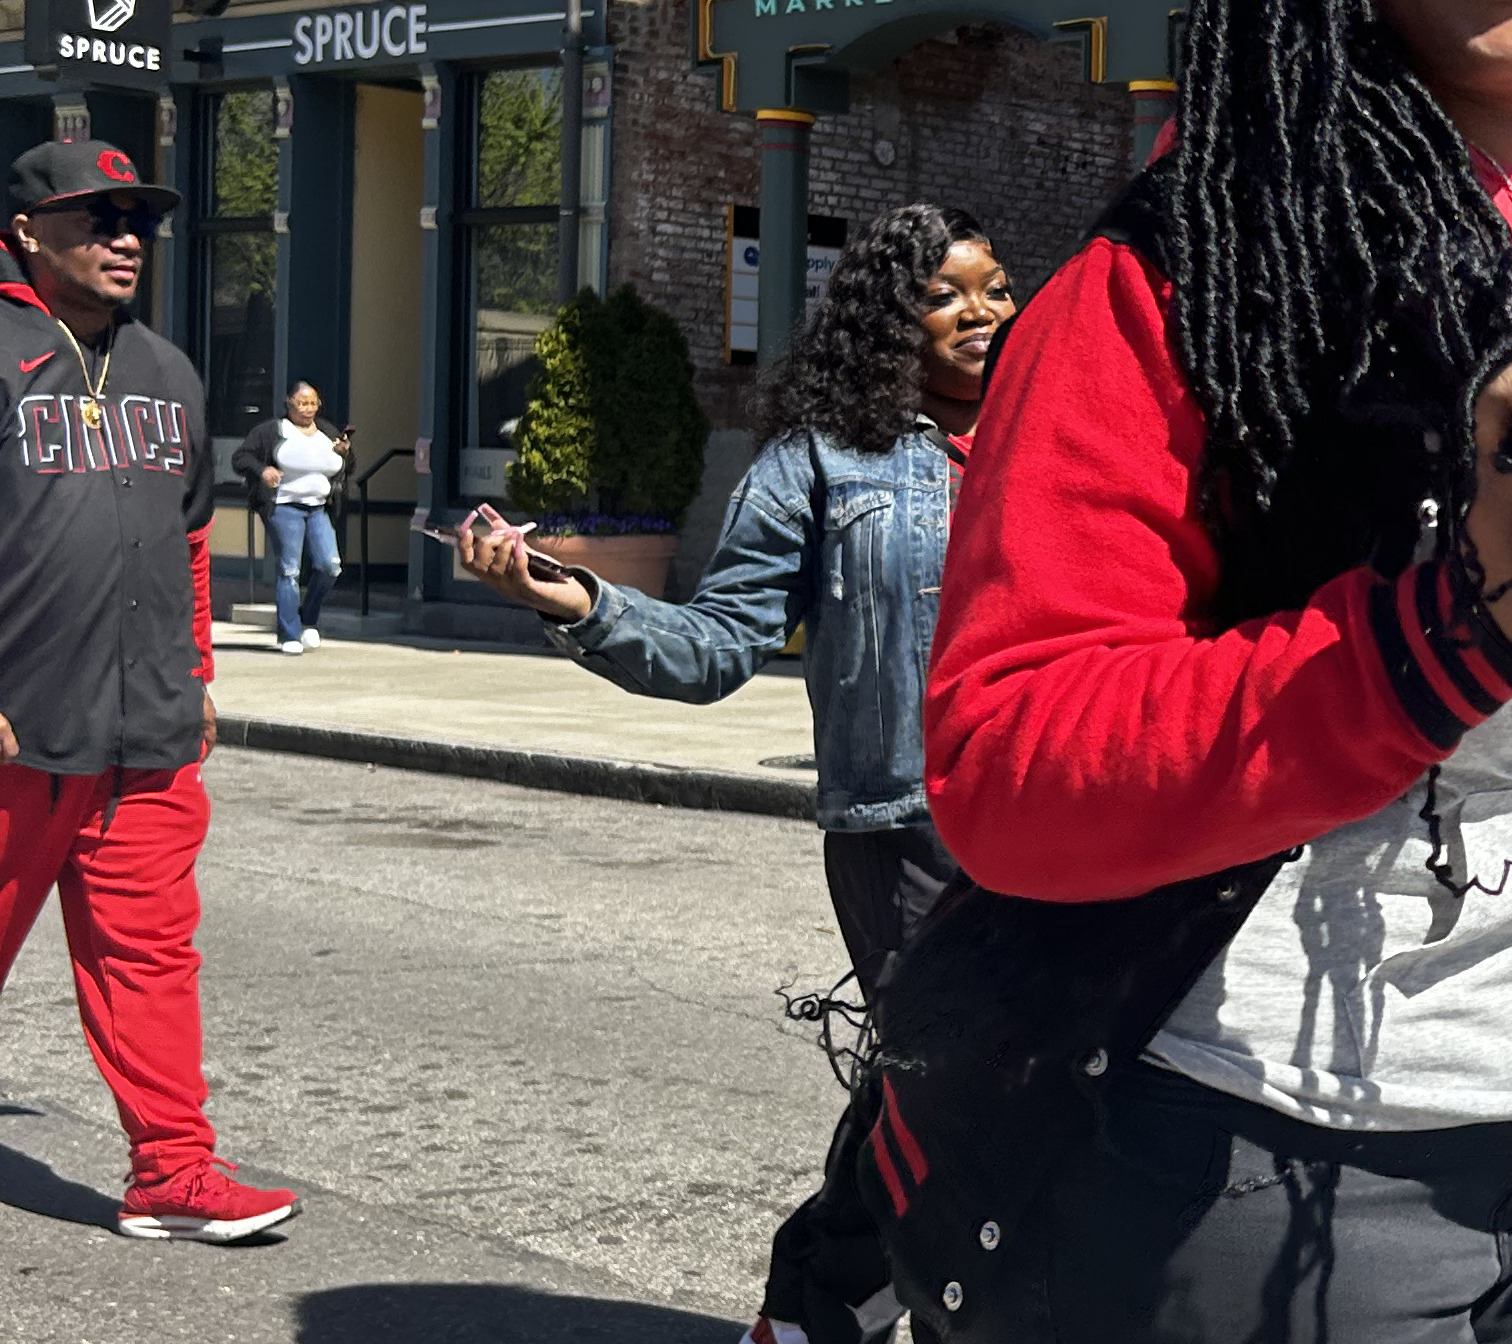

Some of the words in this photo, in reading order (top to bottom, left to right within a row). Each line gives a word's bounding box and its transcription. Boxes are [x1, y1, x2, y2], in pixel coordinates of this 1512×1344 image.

[59, 34, 161, 71] SPRUCE
[295, 4, 428, 66] SPRUCE
[97, 150, 134, 182] C
[18, 393, 189, 476] CINCY
